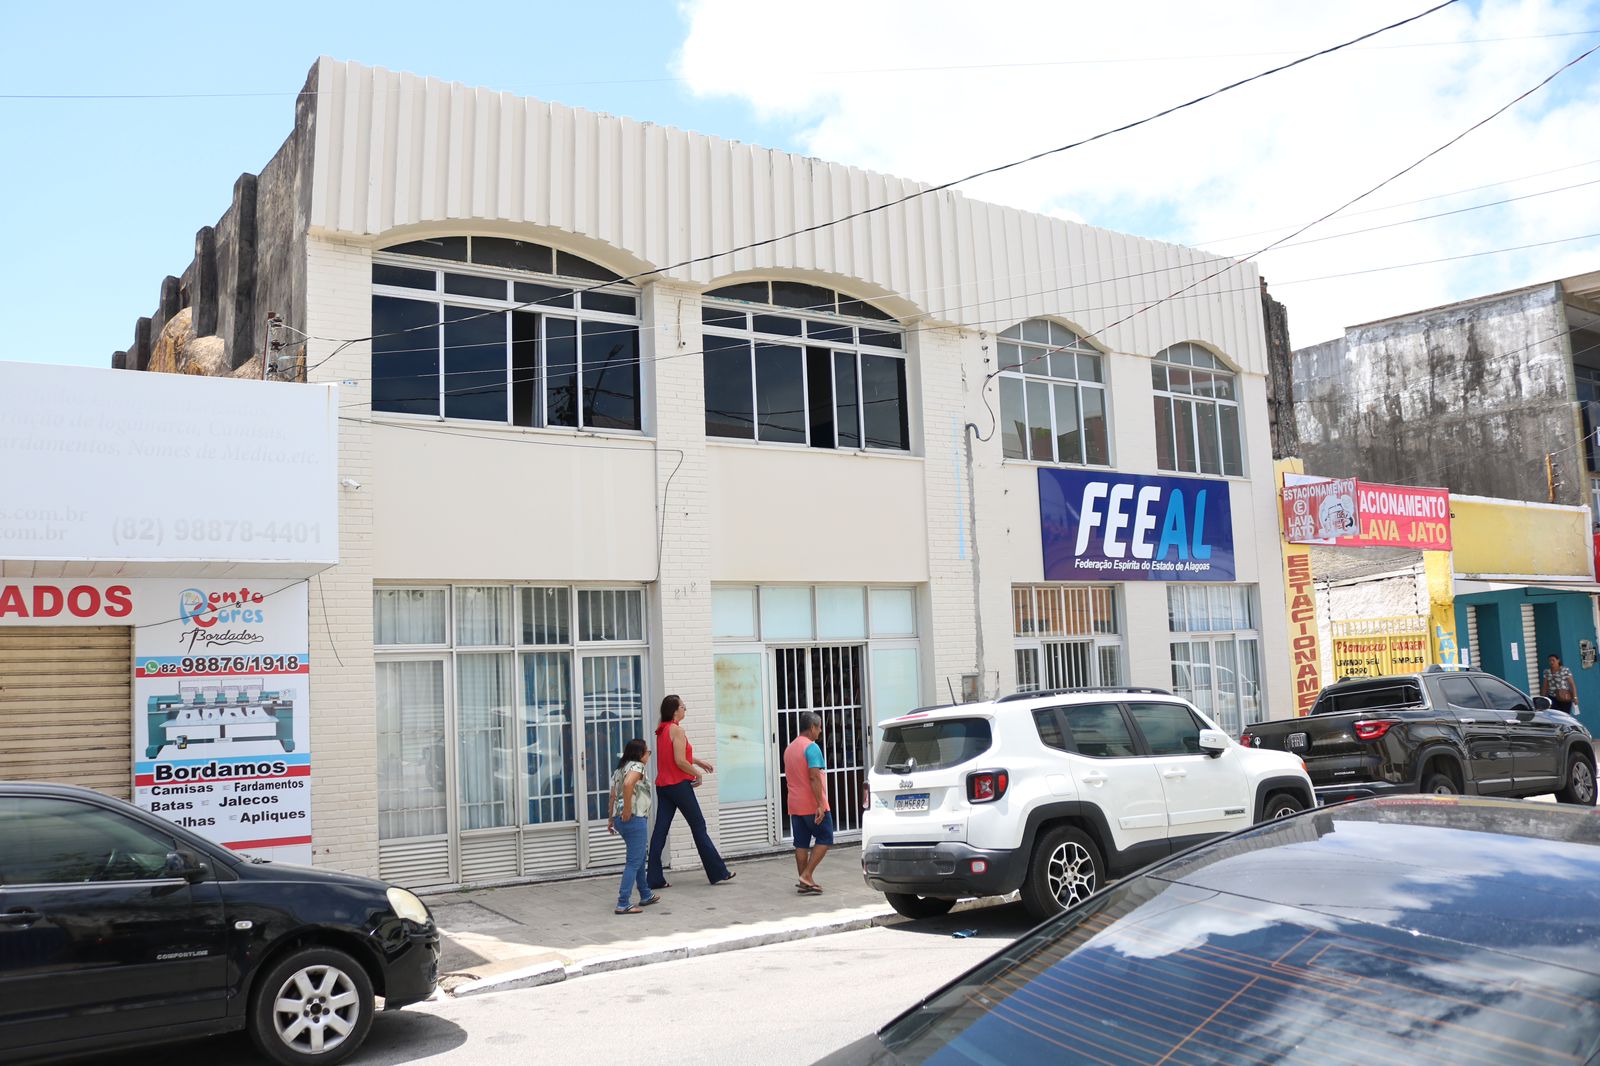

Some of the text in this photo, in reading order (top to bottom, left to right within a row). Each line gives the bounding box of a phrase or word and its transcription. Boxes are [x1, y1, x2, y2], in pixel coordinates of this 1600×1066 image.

[1283, 480, 1354, 500] ESTACIONAMENTO
[1074, 481, 1212, 561] FEEAL
[1288, 515, 1314, 528] LAVA
[111, 515, 321, 546] (82) 98878-4401
[1289, 525, 1315, 539] JATO
[1360, 519, 1447, 544] LAVA JATO
[1074, 558, 1210, 573] Federação Espírita do Estado de Alagoas
[0, 585, 133, 618] ADOS
[191, 628, 261, 643] Bordados
[161, 655, 299, 673] 82 98876/1918
[155, 761, 287, 781] Bordamos
[151, 783, 214, 796] Camisas
[234, 779, 304, 792] Fardamentos
[151, 801, 194, 812] Batas
[218, 795, 279, 808] Jalecos
[240, 810, 306, 825] Apliques
